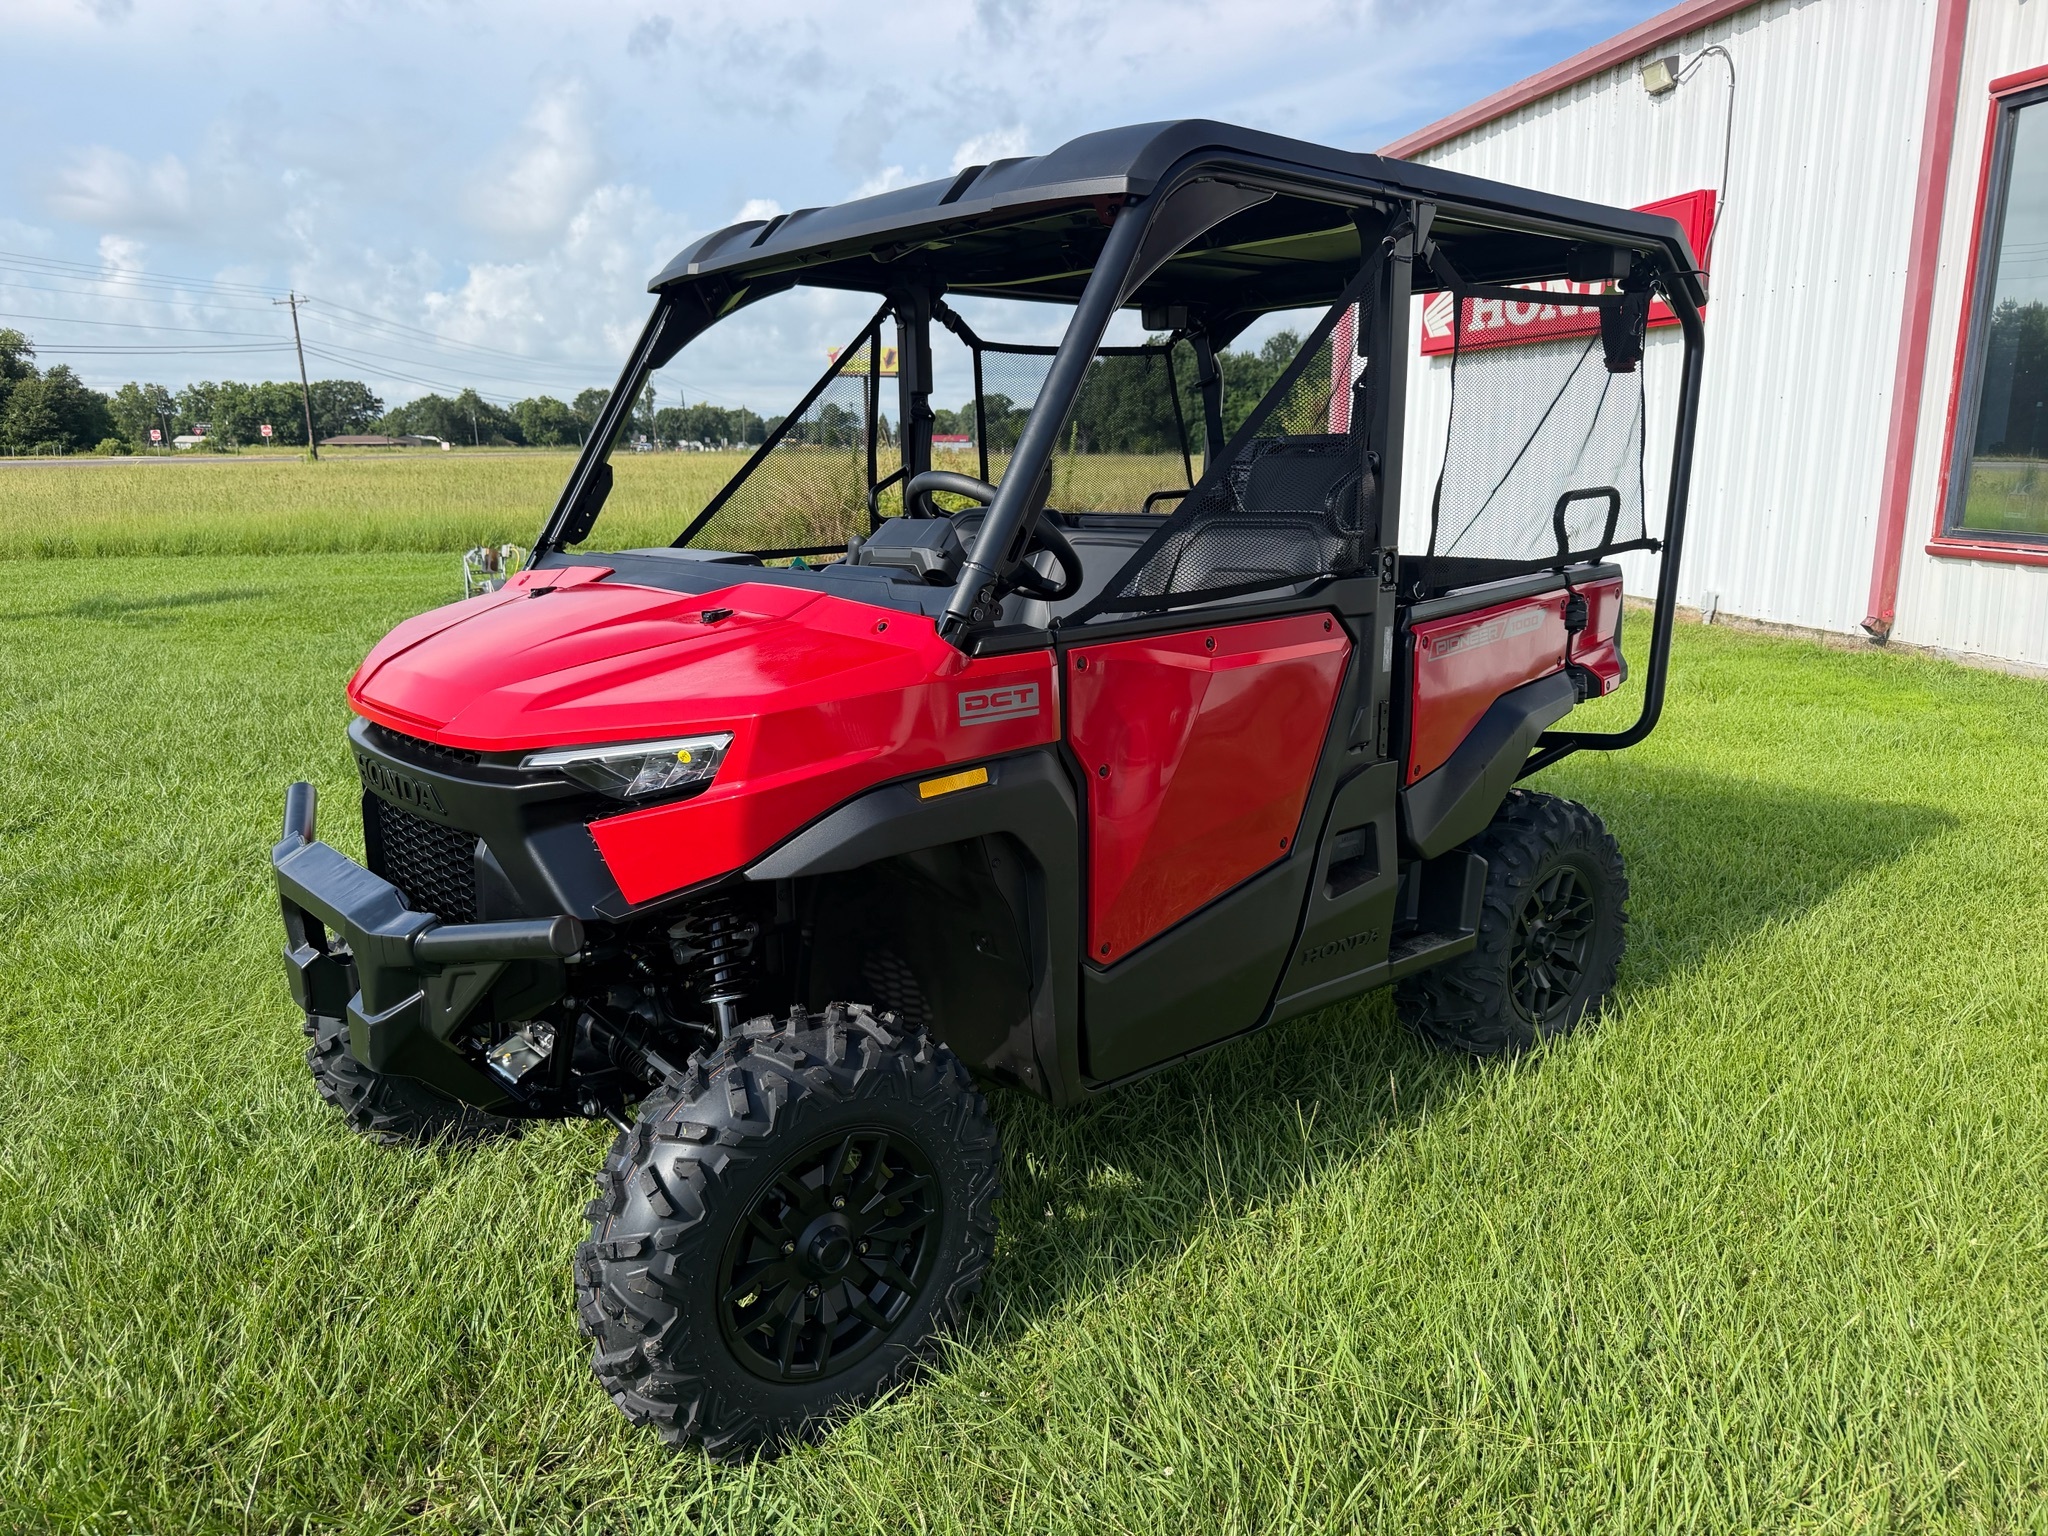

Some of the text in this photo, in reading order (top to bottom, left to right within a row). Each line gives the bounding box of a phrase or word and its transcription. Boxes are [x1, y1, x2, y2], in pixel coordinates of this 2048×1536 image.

[1436, 616, 1539, 655] PIONEER 1000
[965, 688, 1034, 712] DCT
[355, 752, 448, 816] HONDA
[1301, 928, 1380, 966] HONDA
